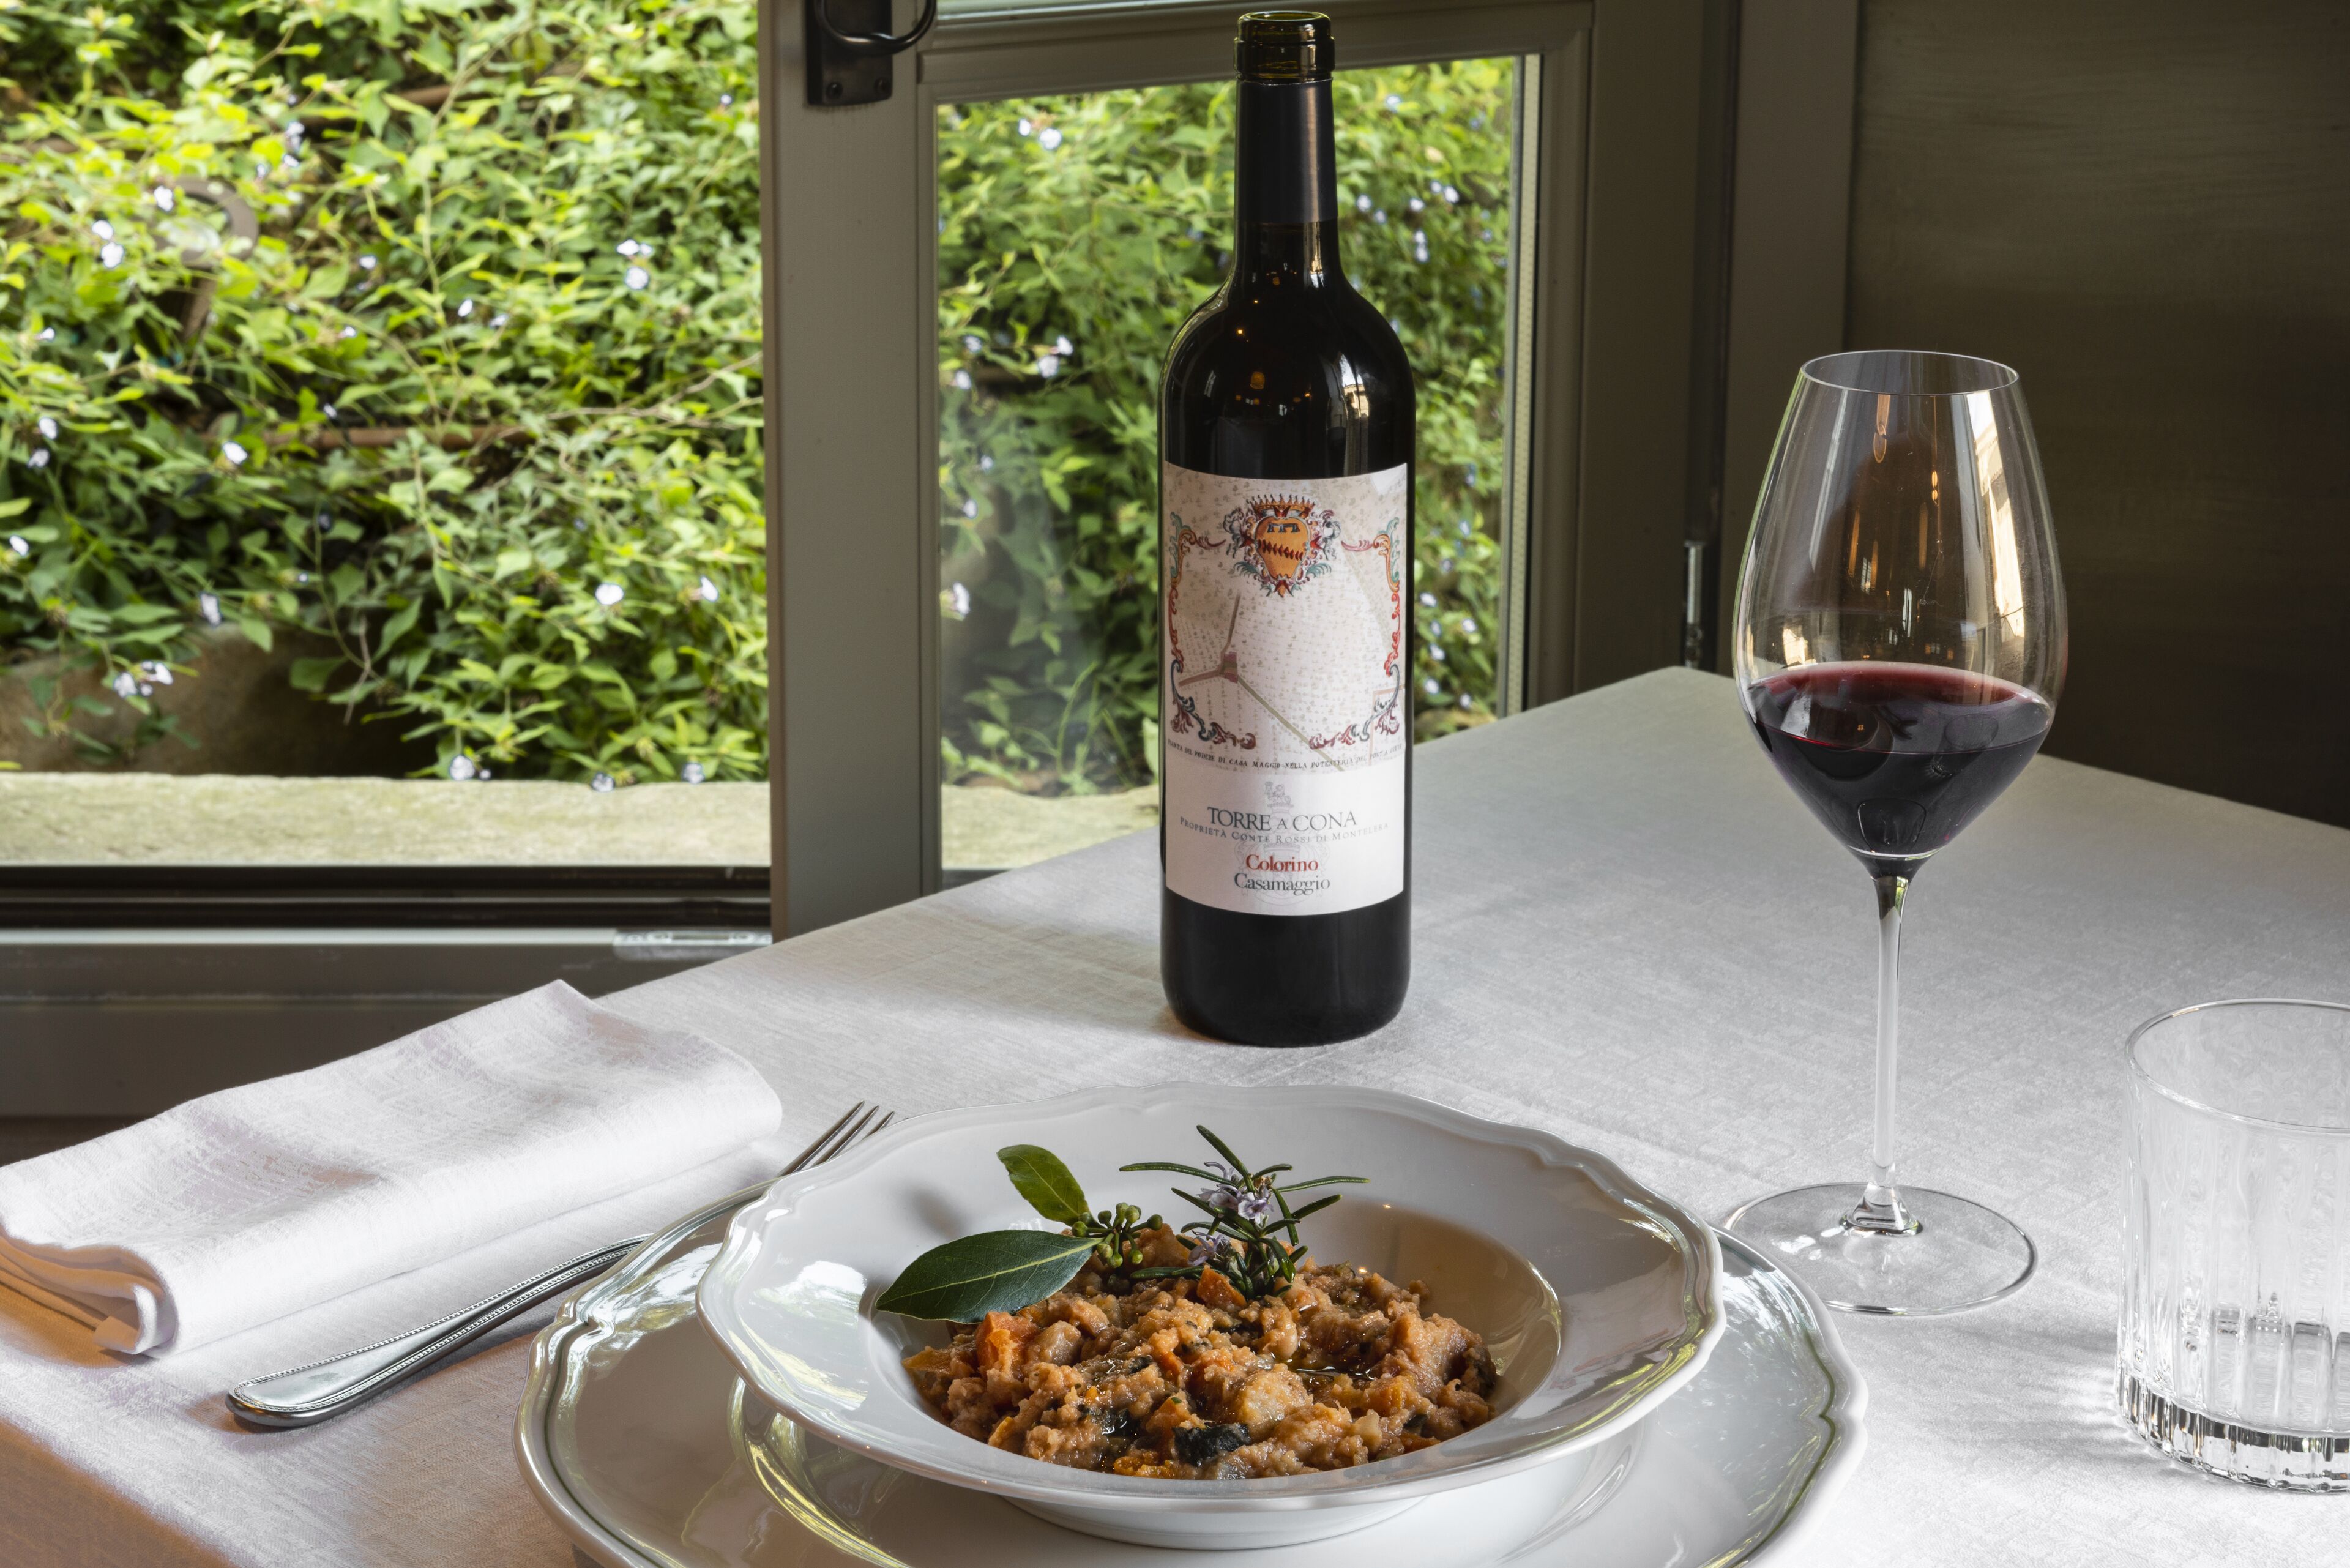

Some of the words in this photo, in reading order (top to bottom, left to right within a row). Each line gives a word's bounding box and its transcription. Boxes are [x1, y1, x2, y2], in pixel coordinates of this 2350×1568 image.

[1207, 806, 1272, 831] TORRE
[1277, 818, 1288, 829] A
[1292, 810, 1357, 832] CONA
[1231, 831, 1270, 843] CONTE
[1275, 835, 1310, 844] ROSSI
[1245, 854, 1319, 872] Colorino
[1234, 872, 1331, 897] Casamaggio
